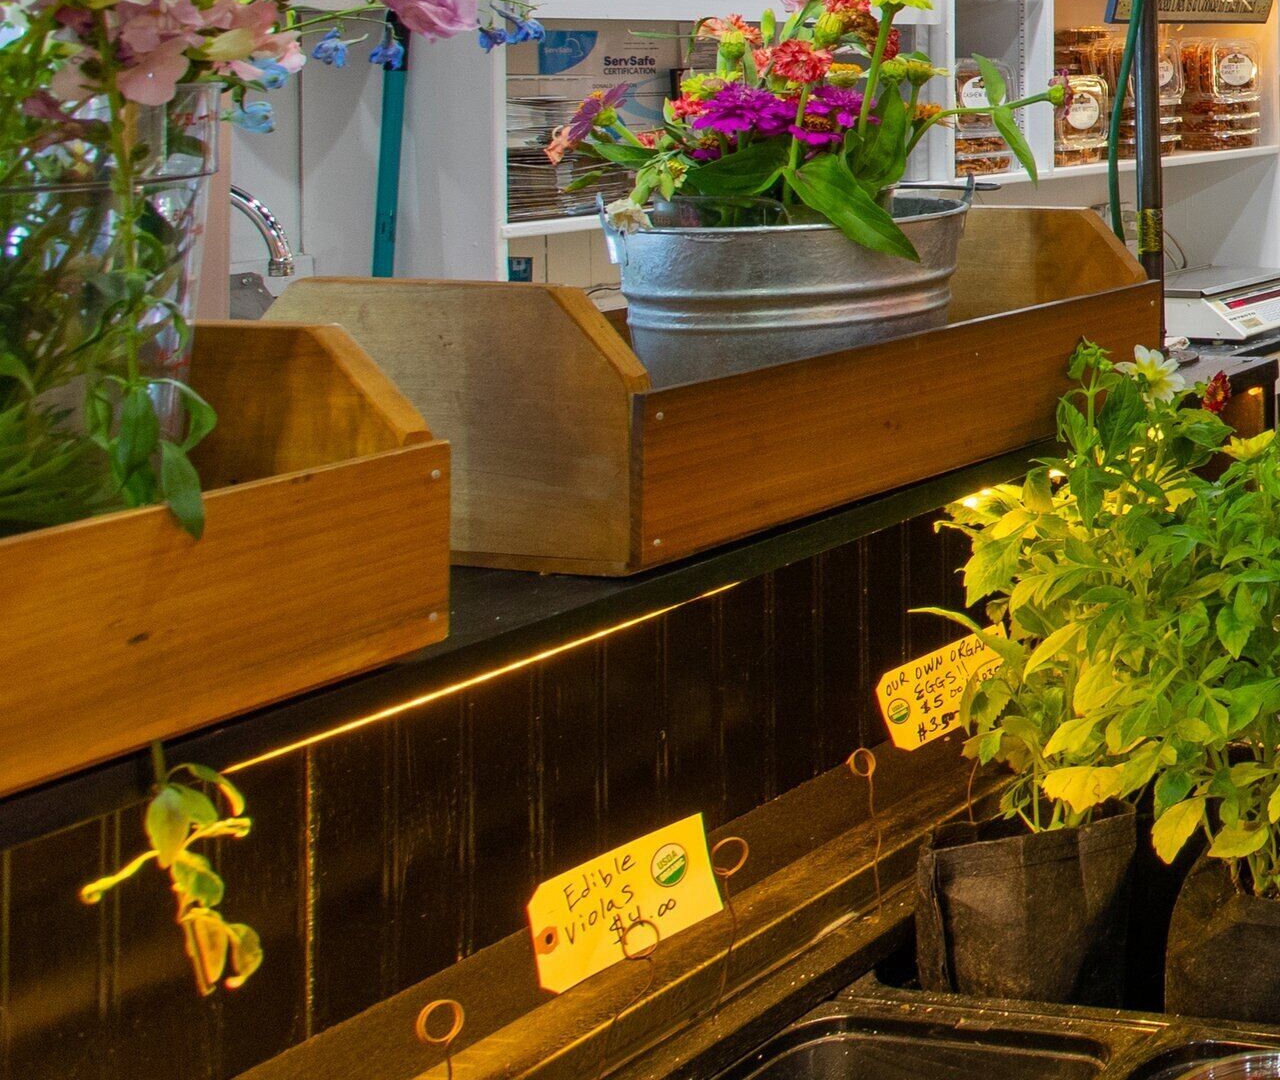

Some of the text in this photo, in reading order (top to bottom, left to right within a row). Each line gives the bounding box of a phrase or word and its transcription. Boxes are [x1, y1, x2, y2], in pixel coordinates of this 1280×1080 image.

[603, 55, 656, 67] ServSafe
[603, 67, 657, 76] CERTIFICATION
[886, 671, 909, 697] OUR
[915, 655, 943, 680] OWN
[950, 639, 985, 662] ORGA
[656, 850, 679, 870] USDA
[562, 854, 637, 912] Edible
[564, 884, 635, 945] Violas
